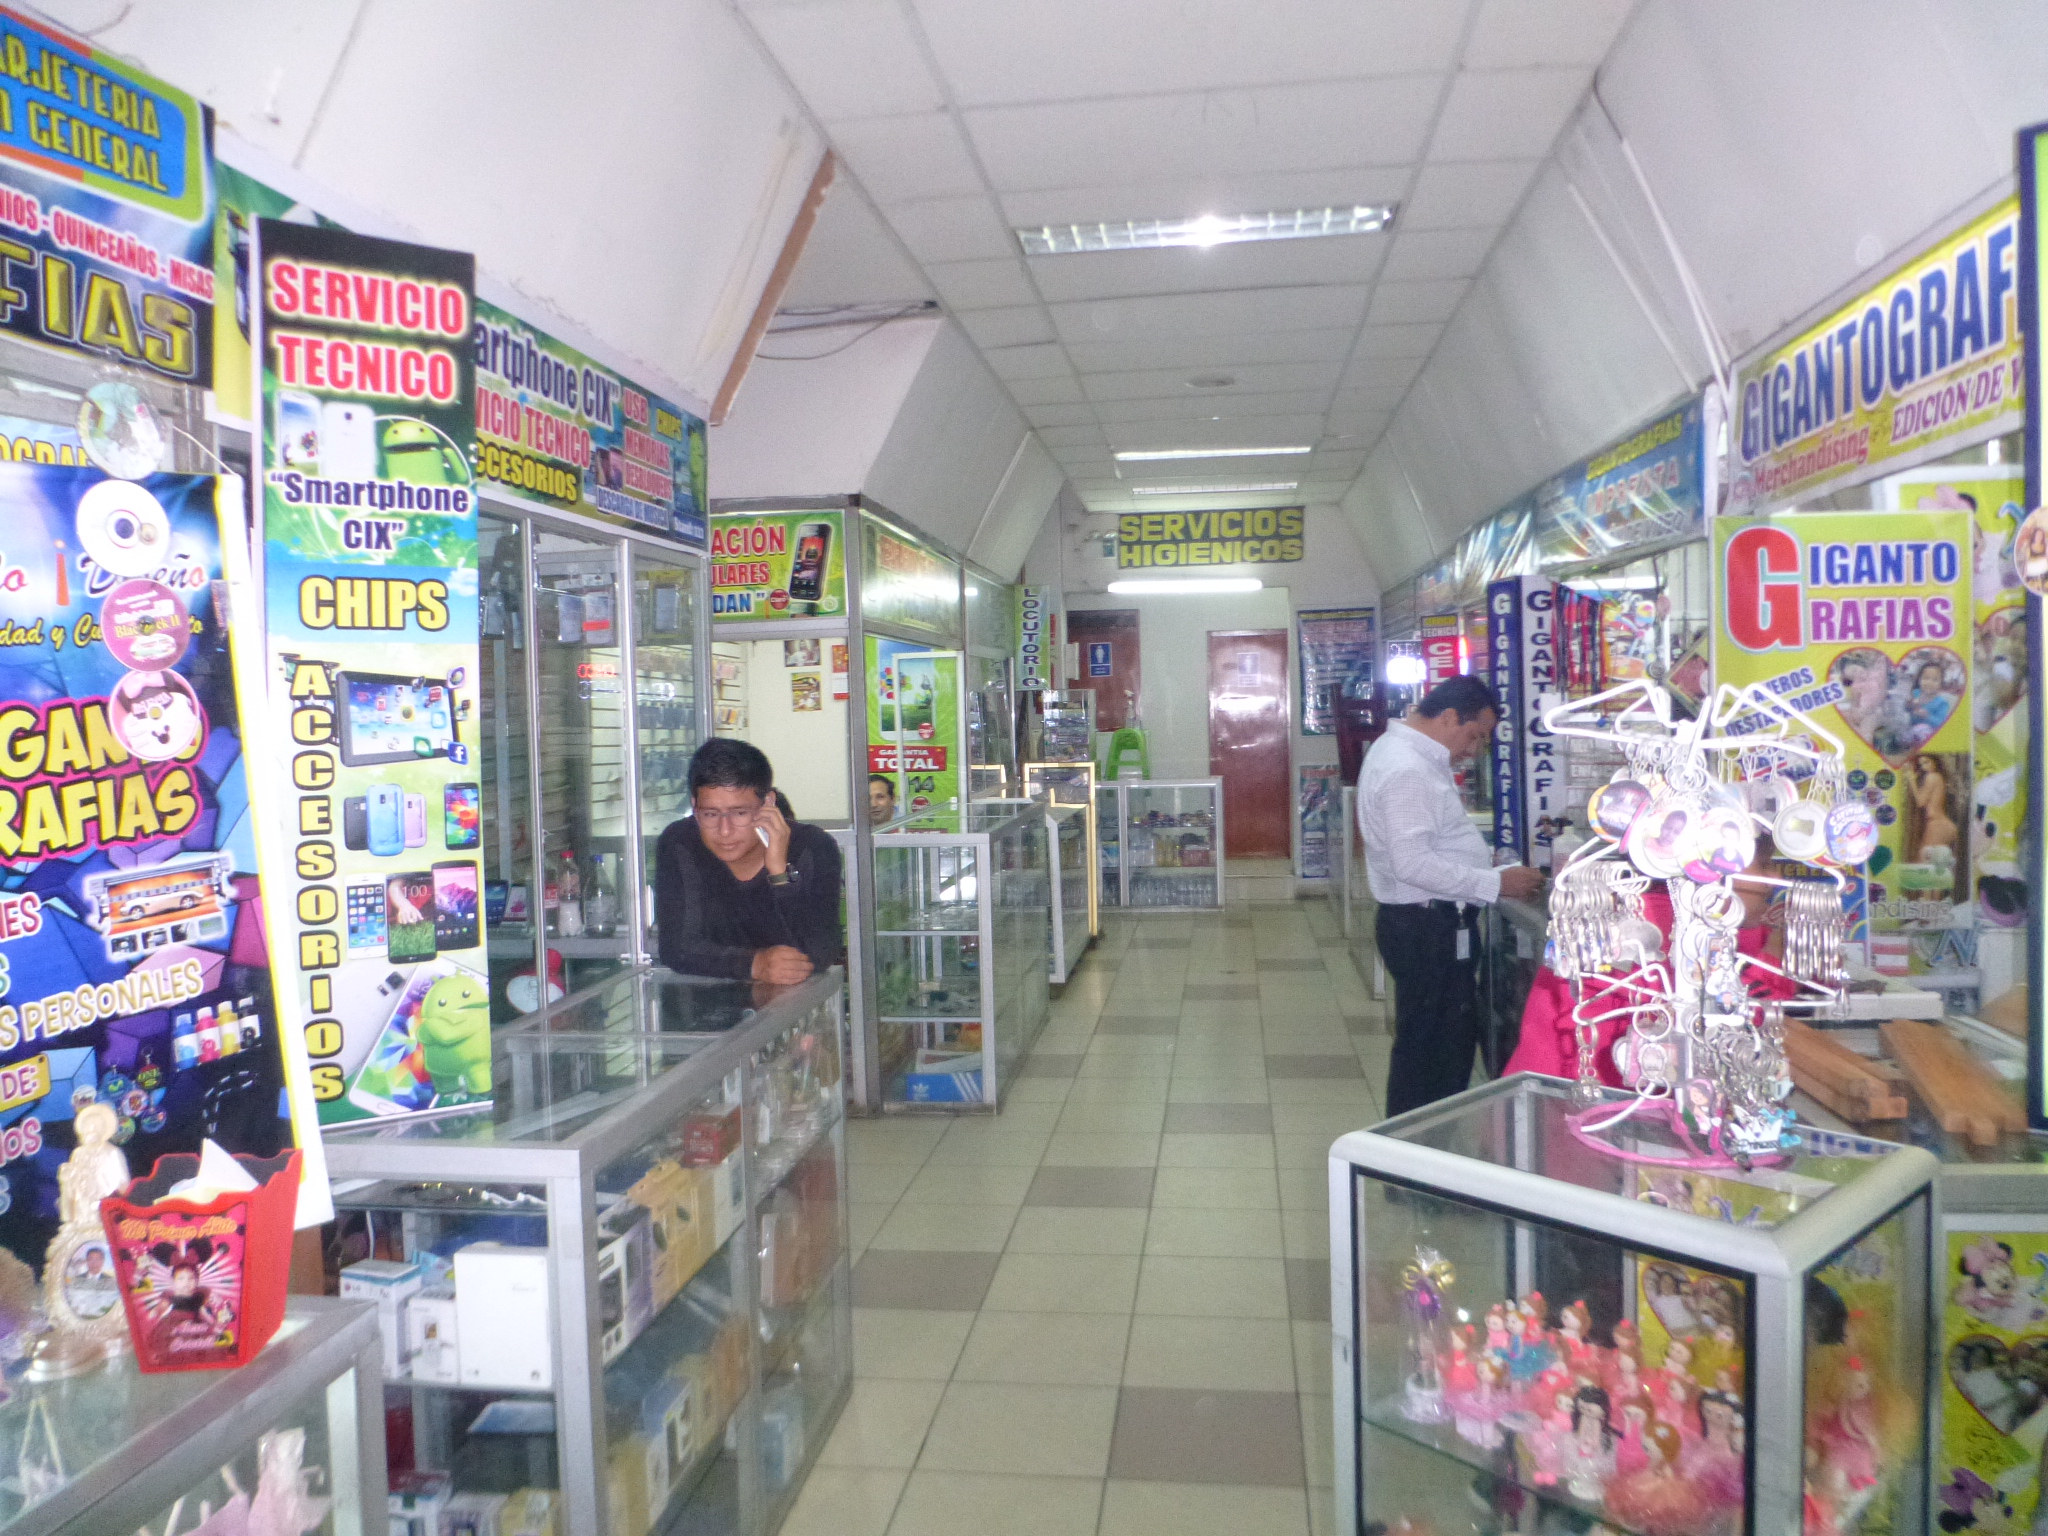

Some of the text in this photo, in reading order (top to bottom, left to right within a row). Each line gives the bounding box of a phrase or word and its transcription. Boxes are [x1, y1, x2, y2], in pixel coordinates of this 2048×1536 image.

[27, 100, 168, 194] GENERAL
[53, 210, 158, 280] QUINCEAÑOS
[169, 258, 213, 299] MISAS
[272, 262, 466, 335] SERVICIO
[277, 334, 454, 400] TECNICO
[525, 406, 590, 468] TECNICO
[1891, 380, 1972, 442] EDICION
[1973, 365, 2004, 410] DE
[1119, 539, 1303, 567] HIGIENICOS
[1120, 508, 1303, 542] SERVICIOS
[300, 576, 449, 629] CHIPS
[1811, 598, 1953, 641] RAFIAS
[1022, 588, 1040, 687] LOCUTORIO
[1429, 642, 1455, 690] CEL
[1493, 592, 1514, 844] GIGANTOGRAFIAS
[874, 757, 939, 770] TOTAL
[291, 659, 345, 1101] ACCESORIOS
[23, 960, 202, 1039] PERSONALES
